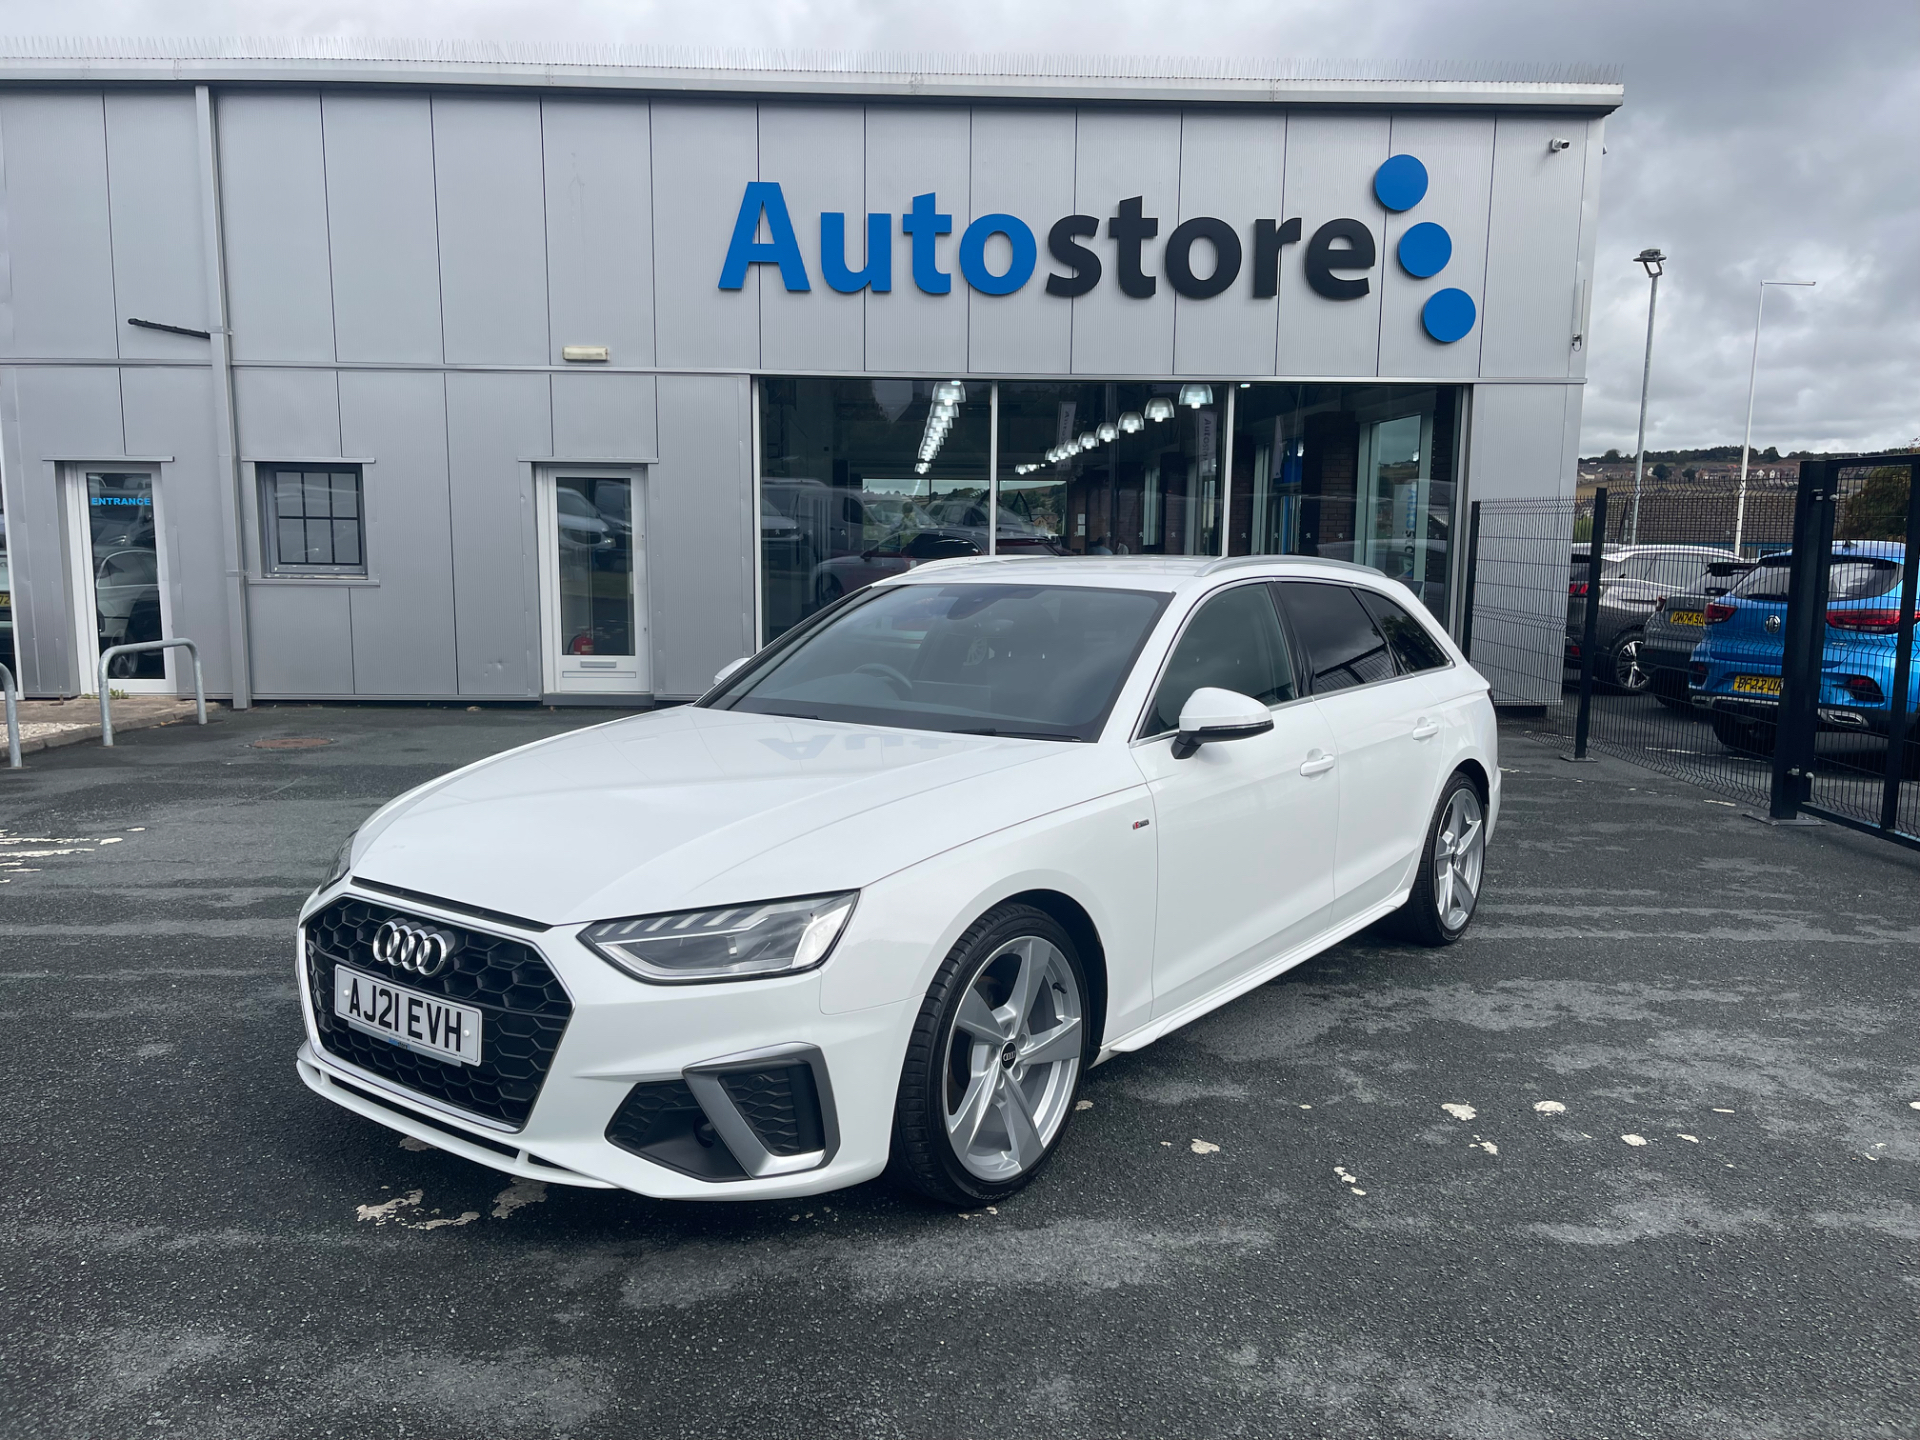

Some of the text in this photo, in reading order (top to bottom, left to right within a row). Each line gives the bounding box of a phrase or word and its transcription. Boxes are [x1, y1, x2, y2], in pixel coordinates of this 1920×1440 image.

[717, 181, 1377, 300] Autostore
[91, 497, 151, 506] ENTRANCE
[349, 978, 462, 1052] AJ21 EVH
